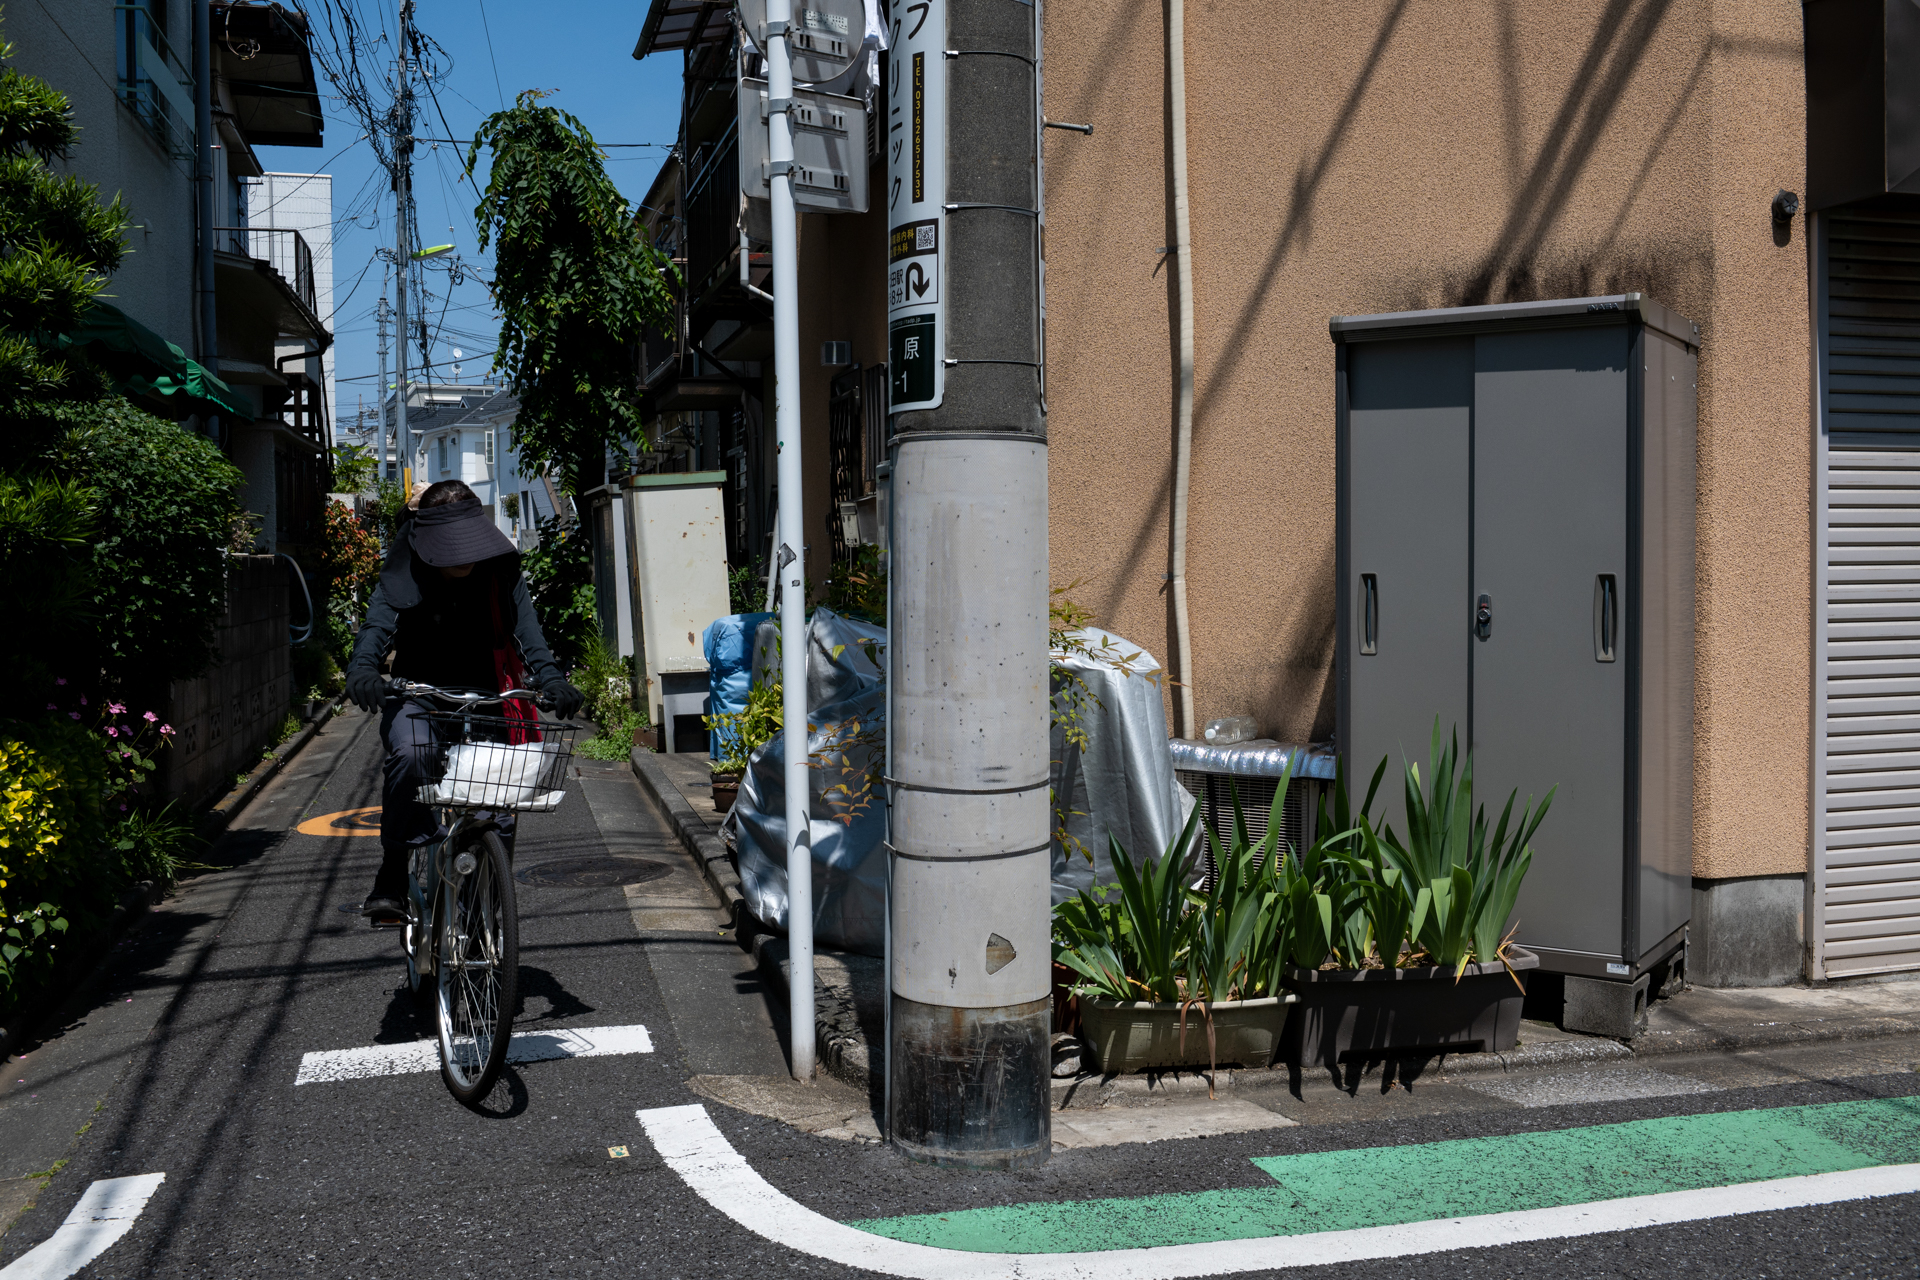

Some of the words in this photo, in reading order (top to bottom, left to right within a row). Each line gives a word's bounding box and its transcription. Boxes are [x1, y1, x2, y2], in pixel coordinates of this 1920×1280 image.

[890, 0, 902, 212] クリニック
[889, 268, 904, 290] 田駅
